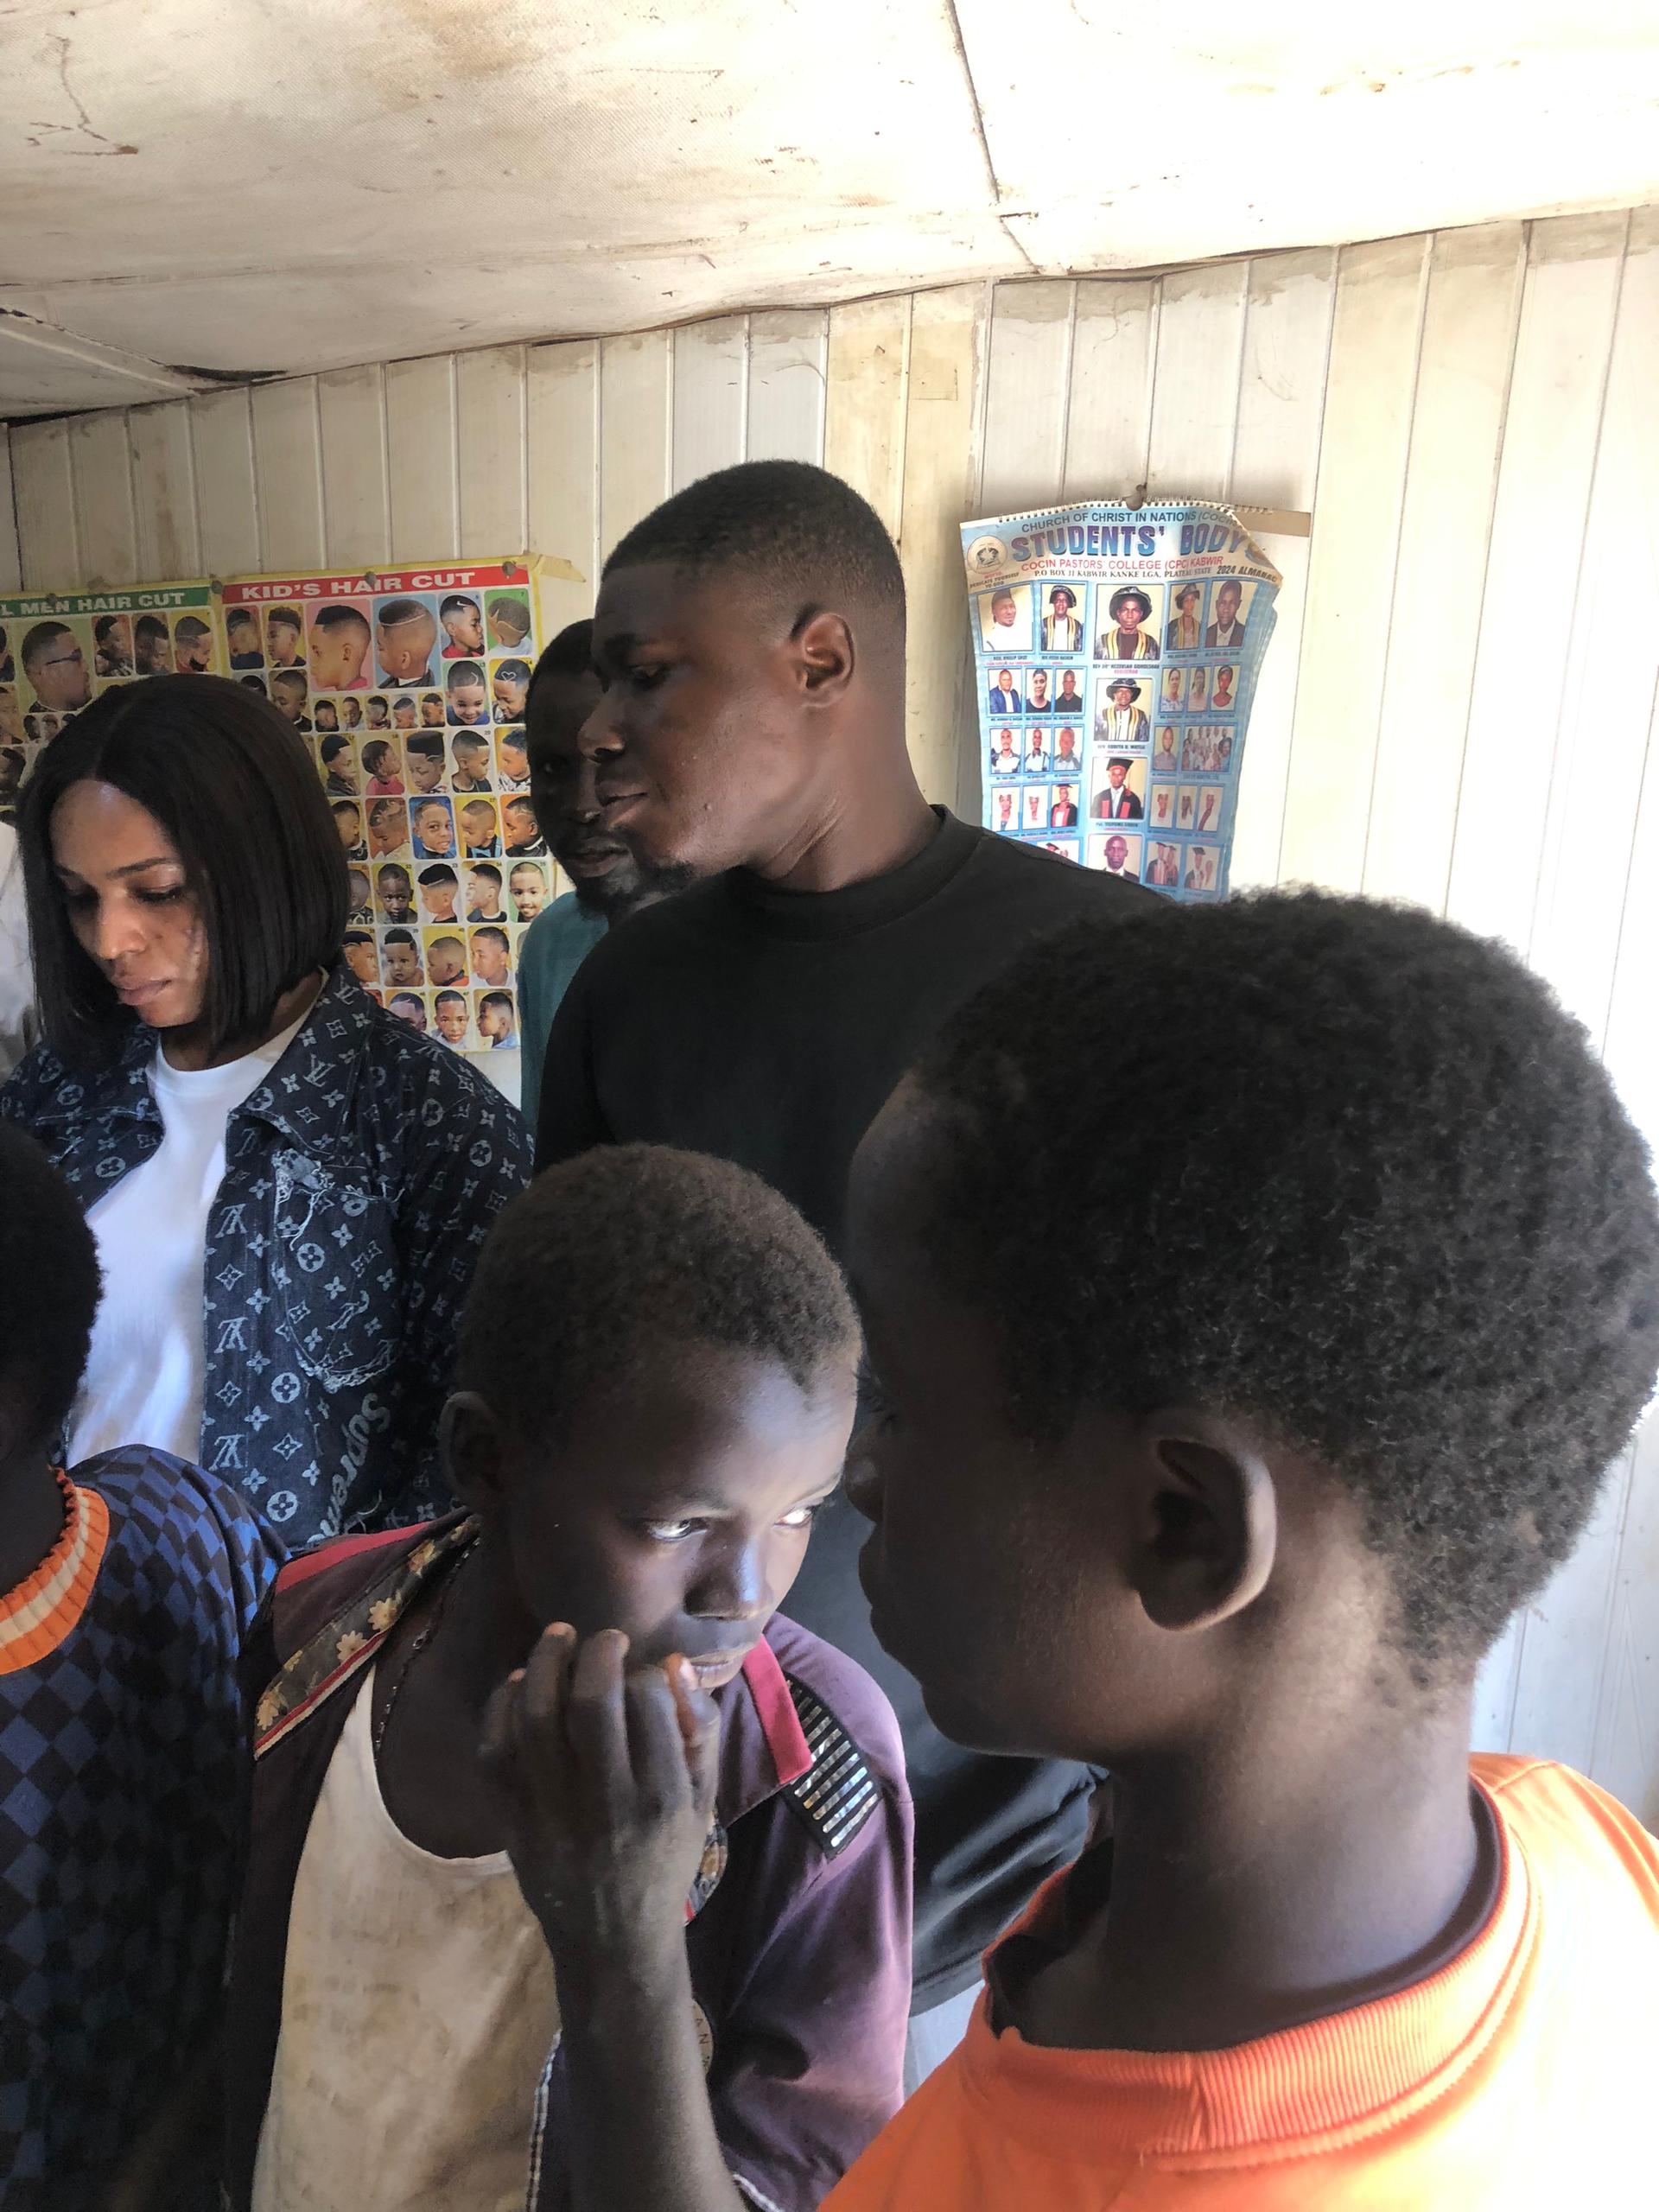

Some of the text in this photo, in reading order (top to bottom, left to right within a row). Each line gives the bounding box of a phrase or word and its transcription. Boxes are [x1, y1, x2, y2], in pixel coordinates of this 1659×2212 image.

[1021, 515, 1071, 533] CHURCH
[1073, 512, 1089, 523] OF
[1091, 512, 1134, 523] CHRIST
[1135, 512, 1147, 522] IN
[1149, 512, 1197, 522] NATIONS
[1011, 523, 1248, 562] STUDENTS' BODY
[1021, 559, 1056, 572] COCIN
[1109, 560, 1161, 569] COLLEGE
[1190, 556, 1224, 567] KABWIR
[1217, 566, 1236, 575] 2024
[242, 572, 475, 600] KID'S HAIR CUT
[21, 601, 69, 615] MEN
[78, 595, 131, 611] HAIR
[138, 593, 185, 607] CUT
